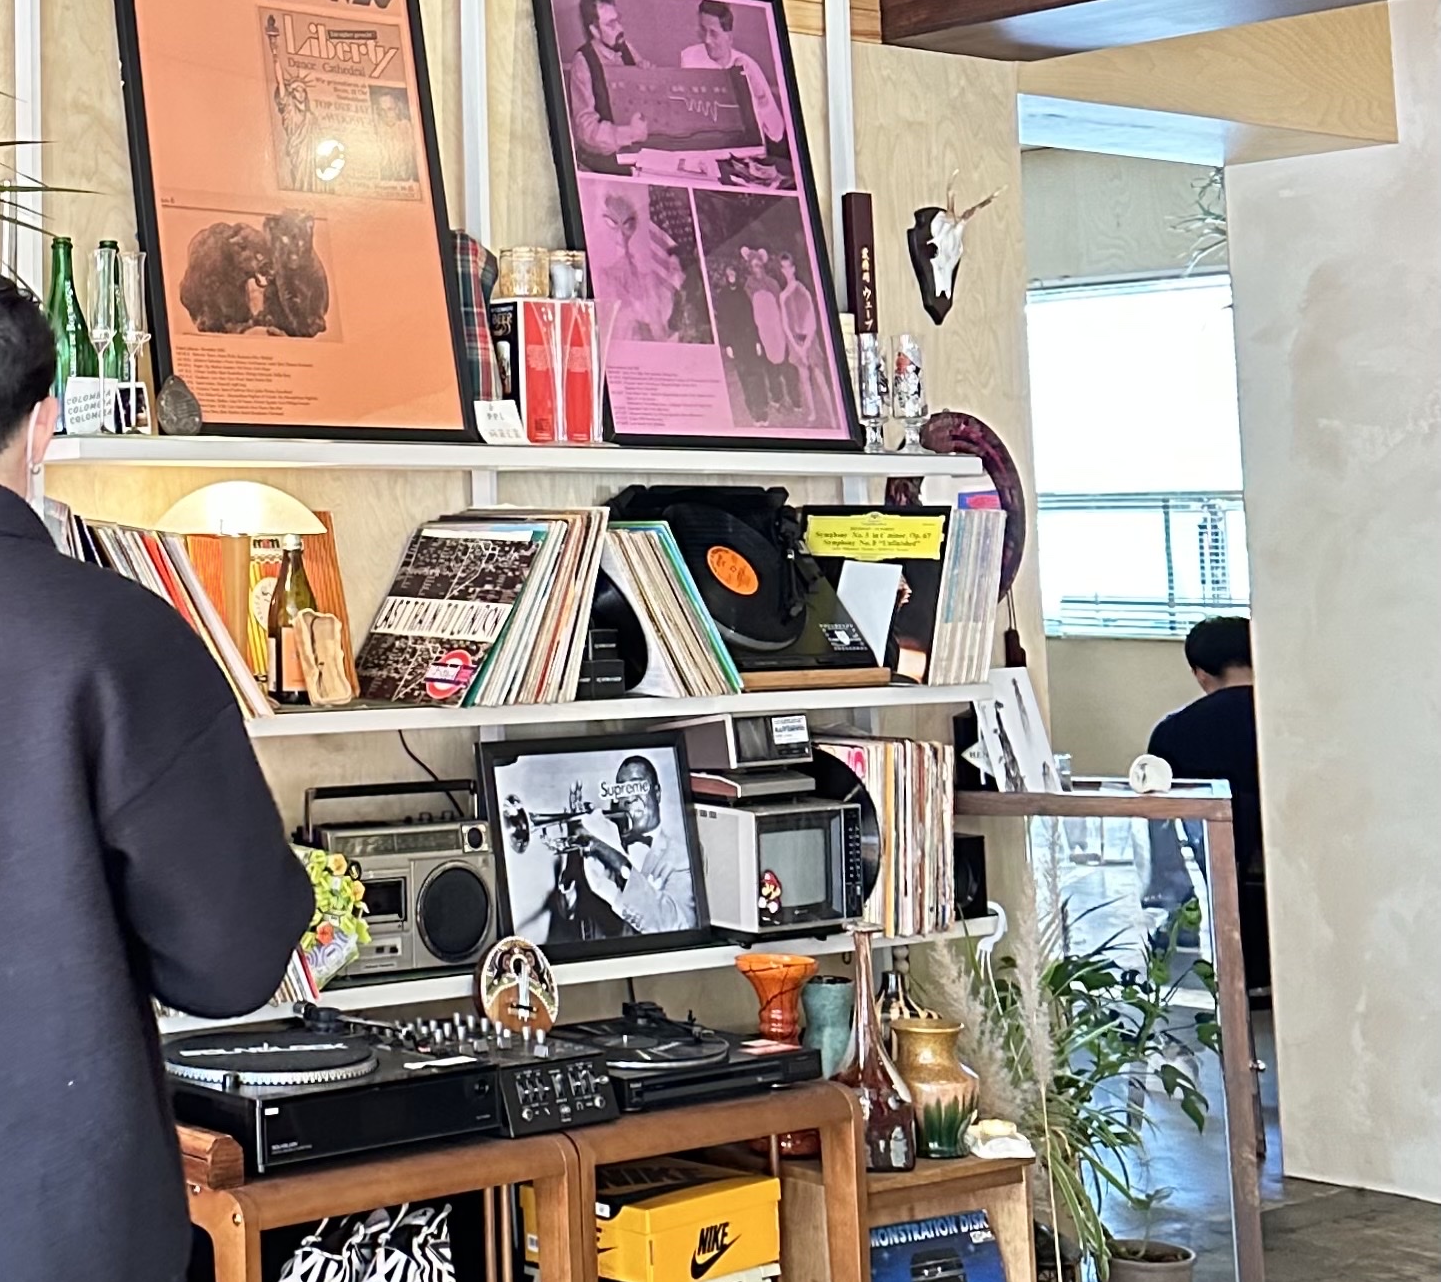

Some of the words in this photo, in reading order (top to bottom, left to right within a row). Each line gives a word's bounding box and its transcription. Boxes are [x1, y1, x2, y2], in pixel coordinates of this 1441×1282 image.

[283, 14, 400, 79] Liberty
[67, 389, 111, 405] COLOMBA
[600, 780, 649, 800] Supreme
[960, 1211, 989, 1232] DISK
[697, 1221, 730, 1256] NIKE
